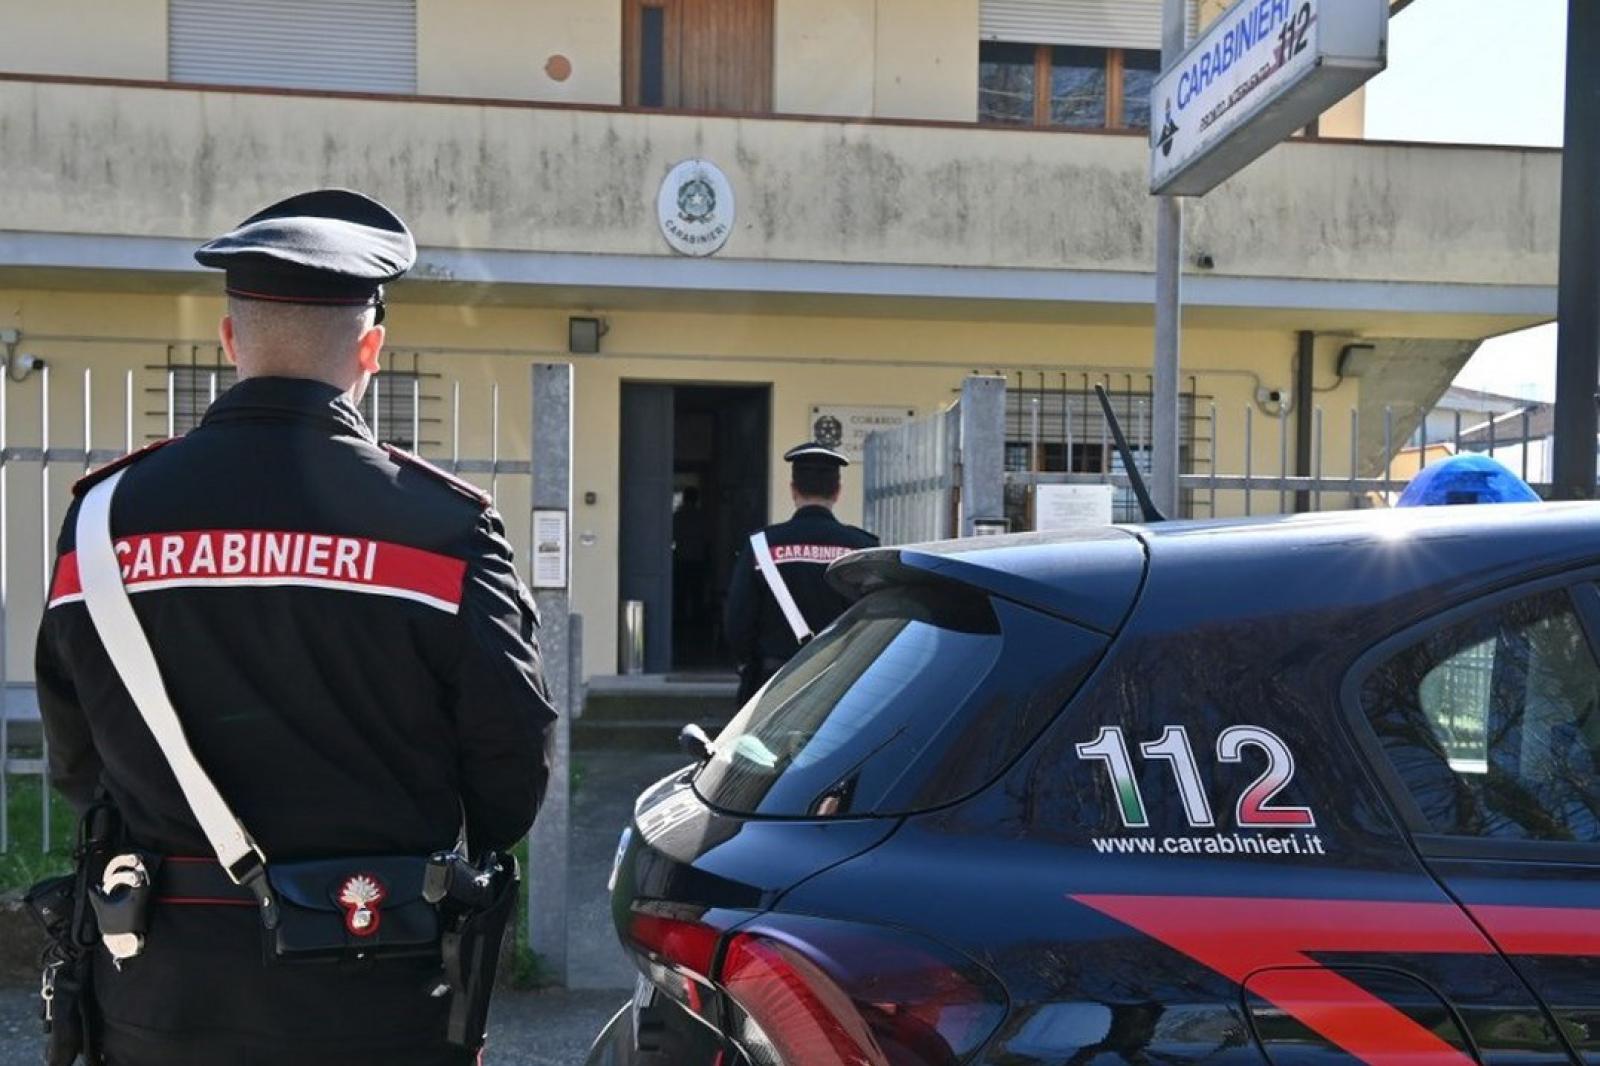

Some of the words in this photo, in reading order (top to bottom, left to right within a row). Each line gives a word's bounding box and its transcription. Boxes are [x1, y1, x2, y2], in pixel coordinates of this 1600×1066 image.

[1278, 2, 1311, 61] 112
[665, 219, 727, 244] CARABINIERI
[1075, 724, 1316, 828] 112
[1092, 833, 1326, 855] www.carabinieri.it
